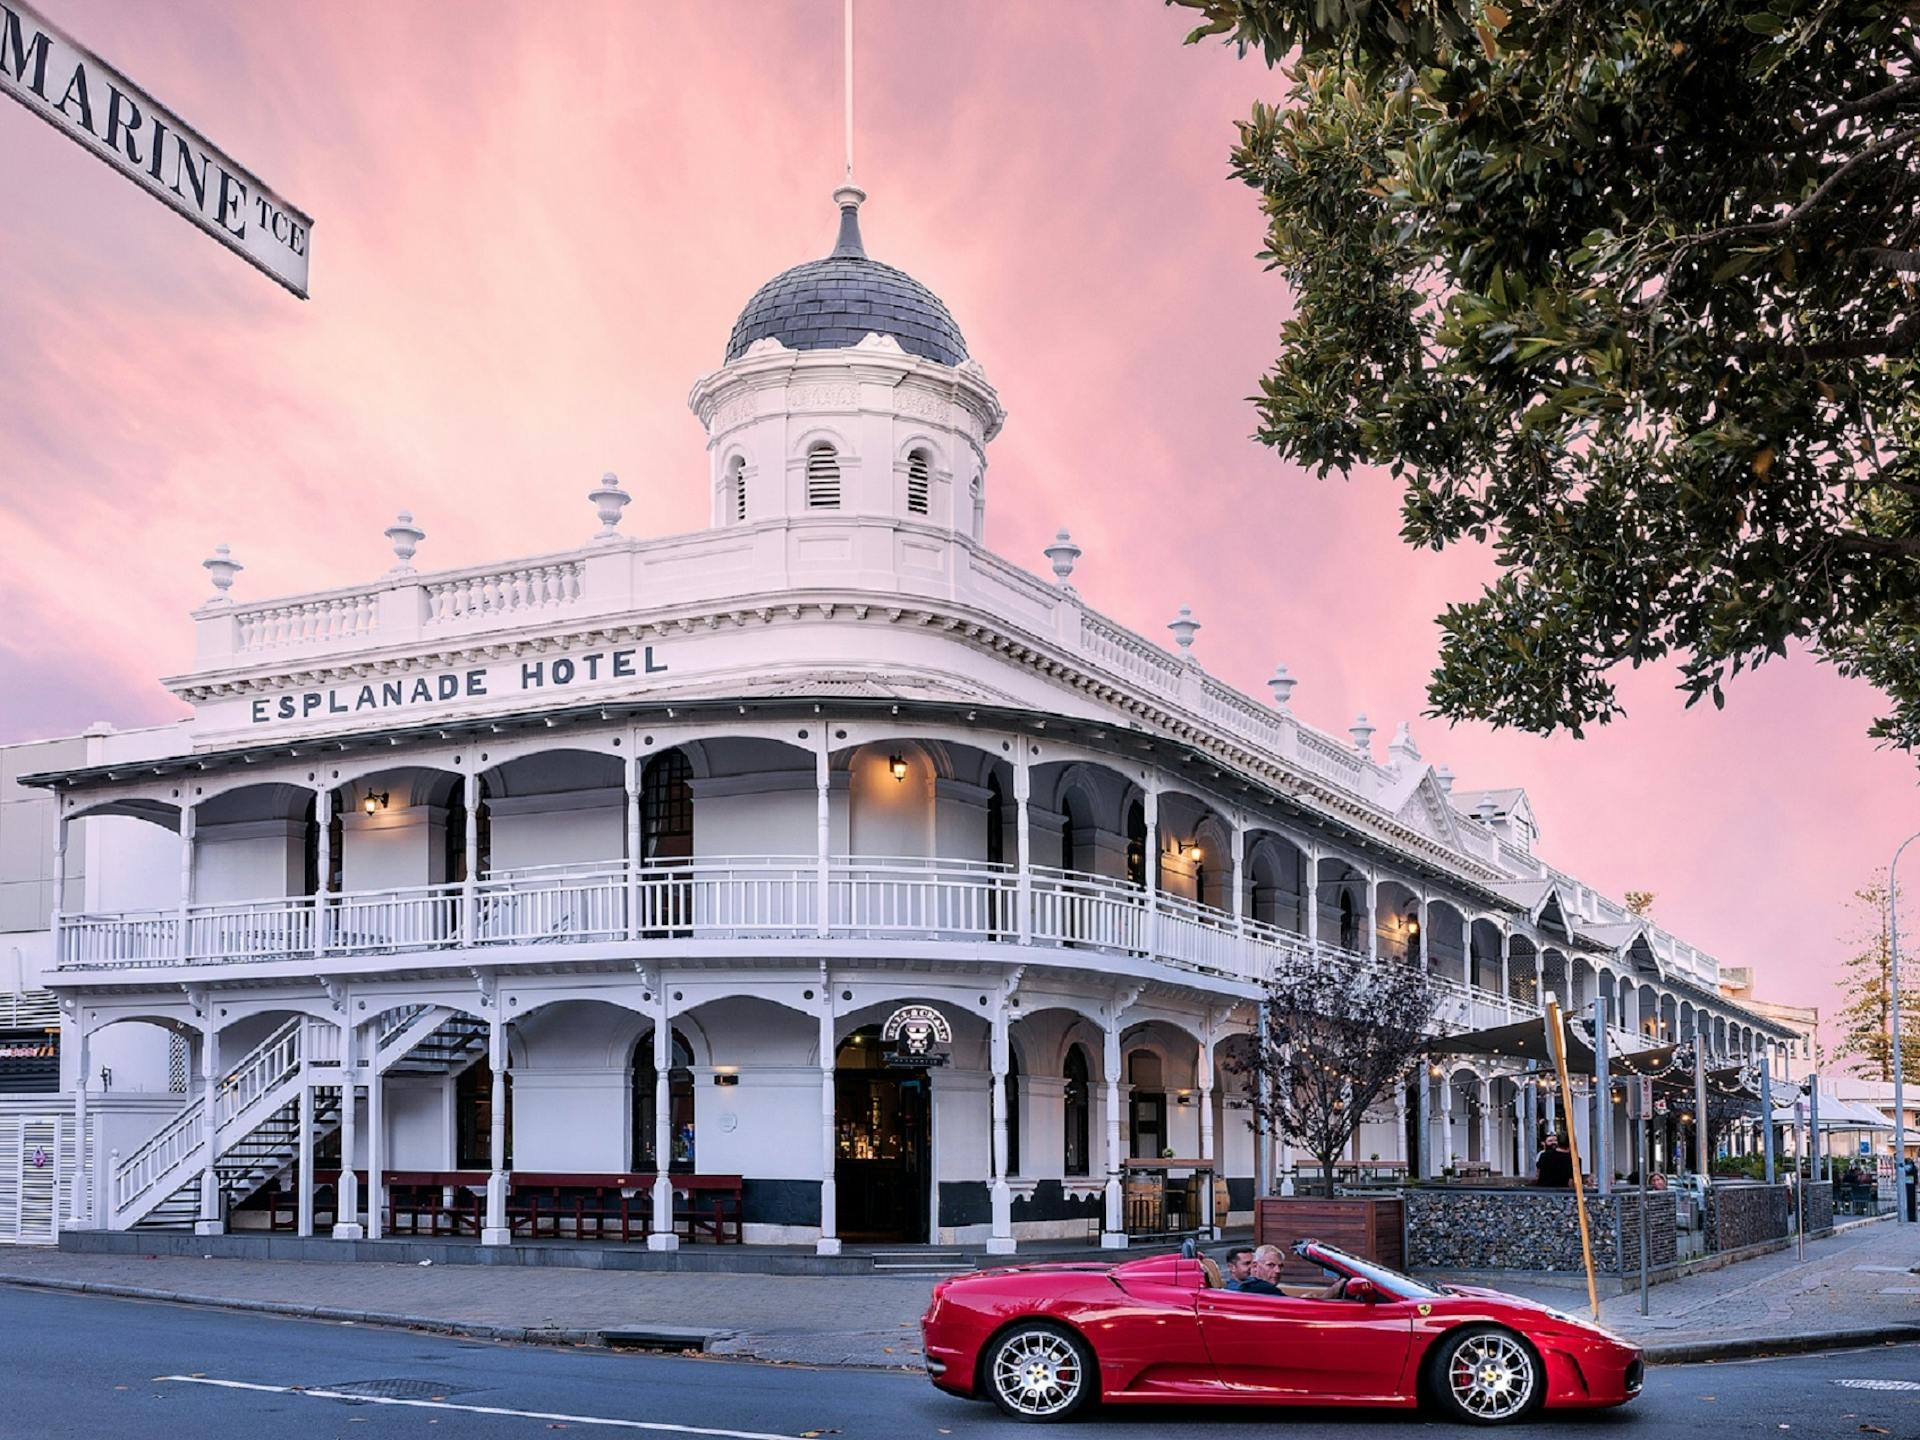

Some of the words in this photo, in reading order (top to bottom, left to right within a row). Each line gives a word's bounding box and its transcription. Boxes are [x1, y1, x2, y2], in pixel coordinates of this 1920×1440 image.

[0, 5, 247, 240] MARINE
[256, 196, 305, 256] TCE
[252, 669, 487, 723] ESPLANADE
[522, 646, 669, 689] HOTEL
